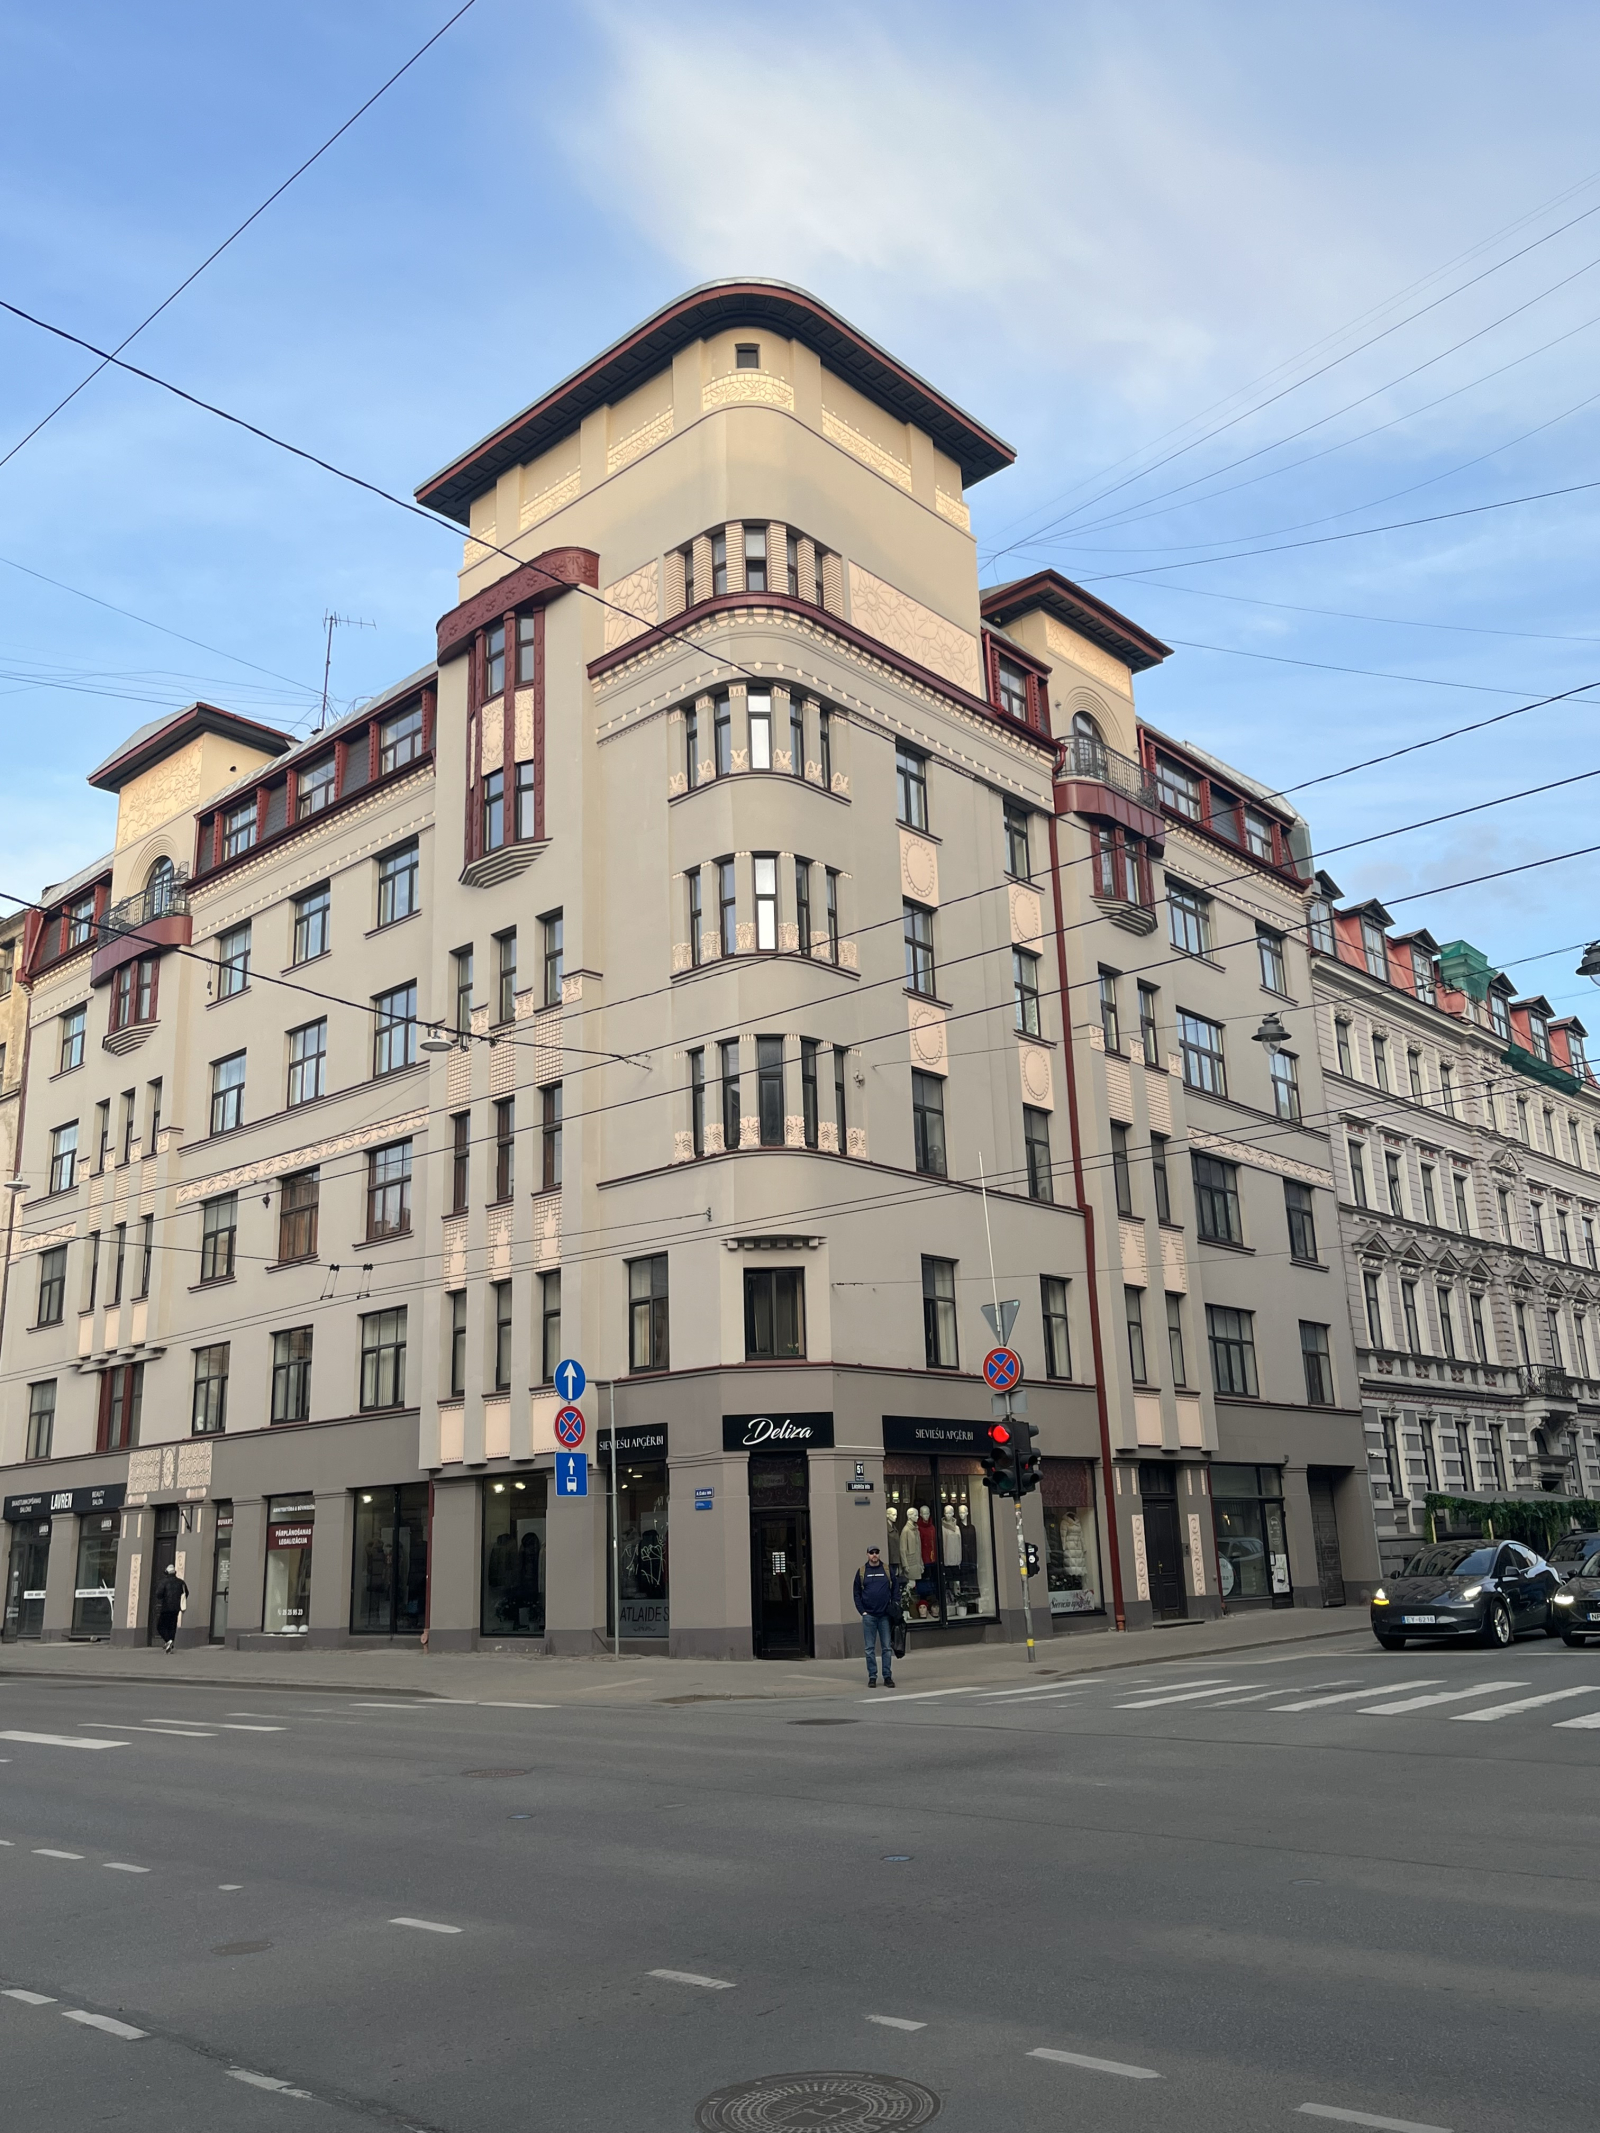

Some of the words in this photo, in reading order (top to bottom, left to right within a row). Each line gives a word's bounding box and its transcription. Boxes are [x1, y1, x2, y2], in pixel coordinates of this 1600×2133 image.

[742, 1417, 814, 1446] Deliza
[856, 1464, 864, 1474] 51
[50, 1492, 74, 1511] LAVREN
